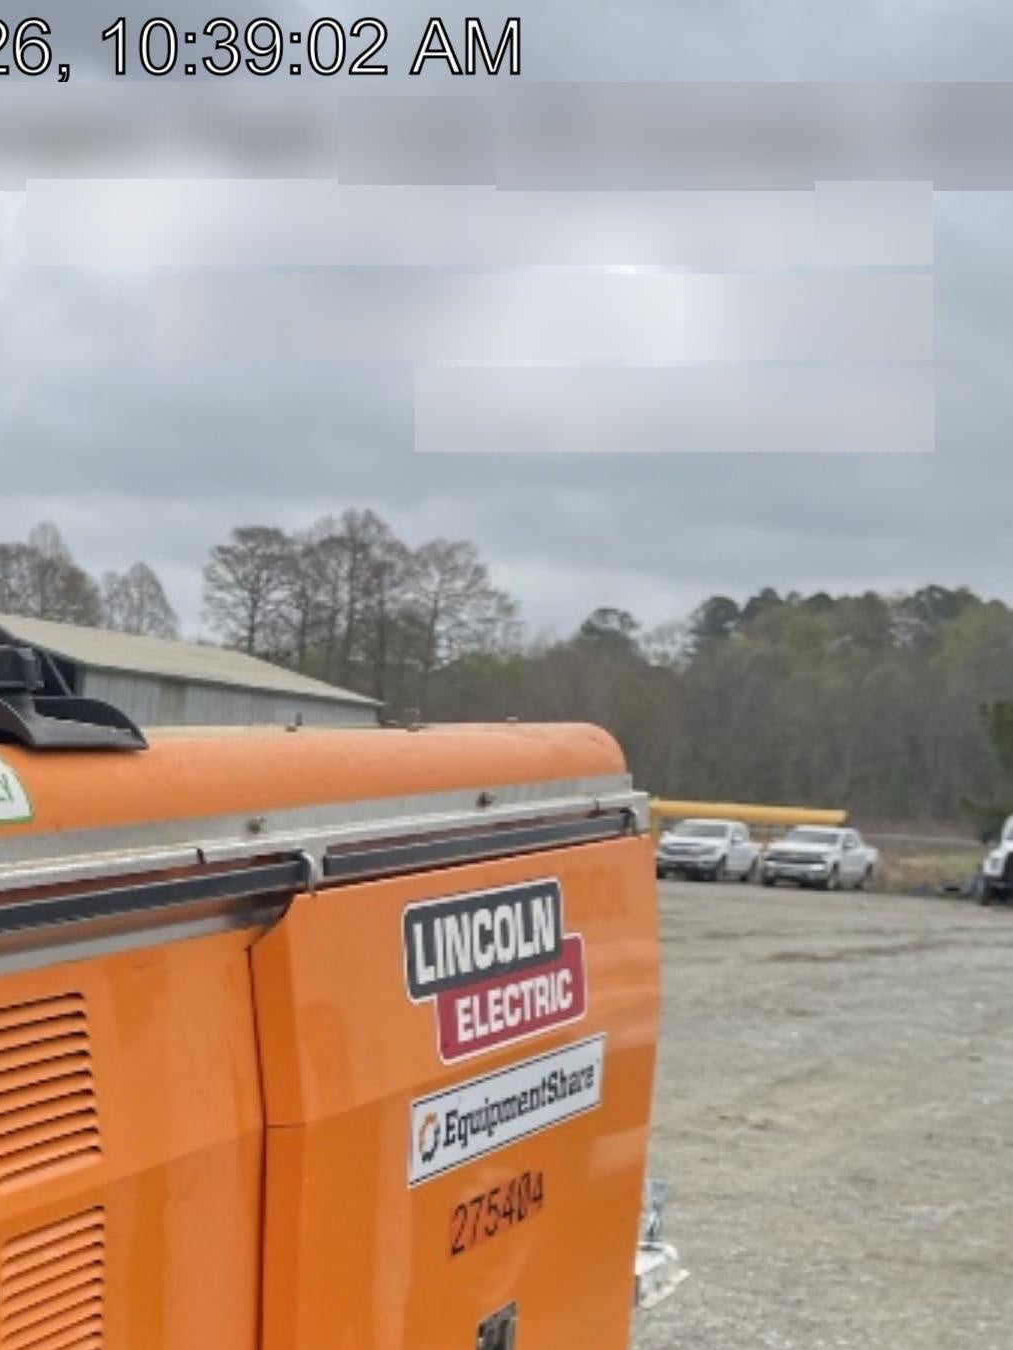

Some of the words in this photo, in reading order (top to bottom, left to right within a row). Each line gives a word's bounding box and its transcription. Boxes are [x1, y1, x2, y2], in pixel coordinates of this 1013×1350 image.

[413, 896, 556, 985] LINCOLN
[455, 967, 574, 1044] ELECTRIC
[442, 1064, 595, 1149] EquipmentShare
[450, 1171, 545, 1256] 275404
